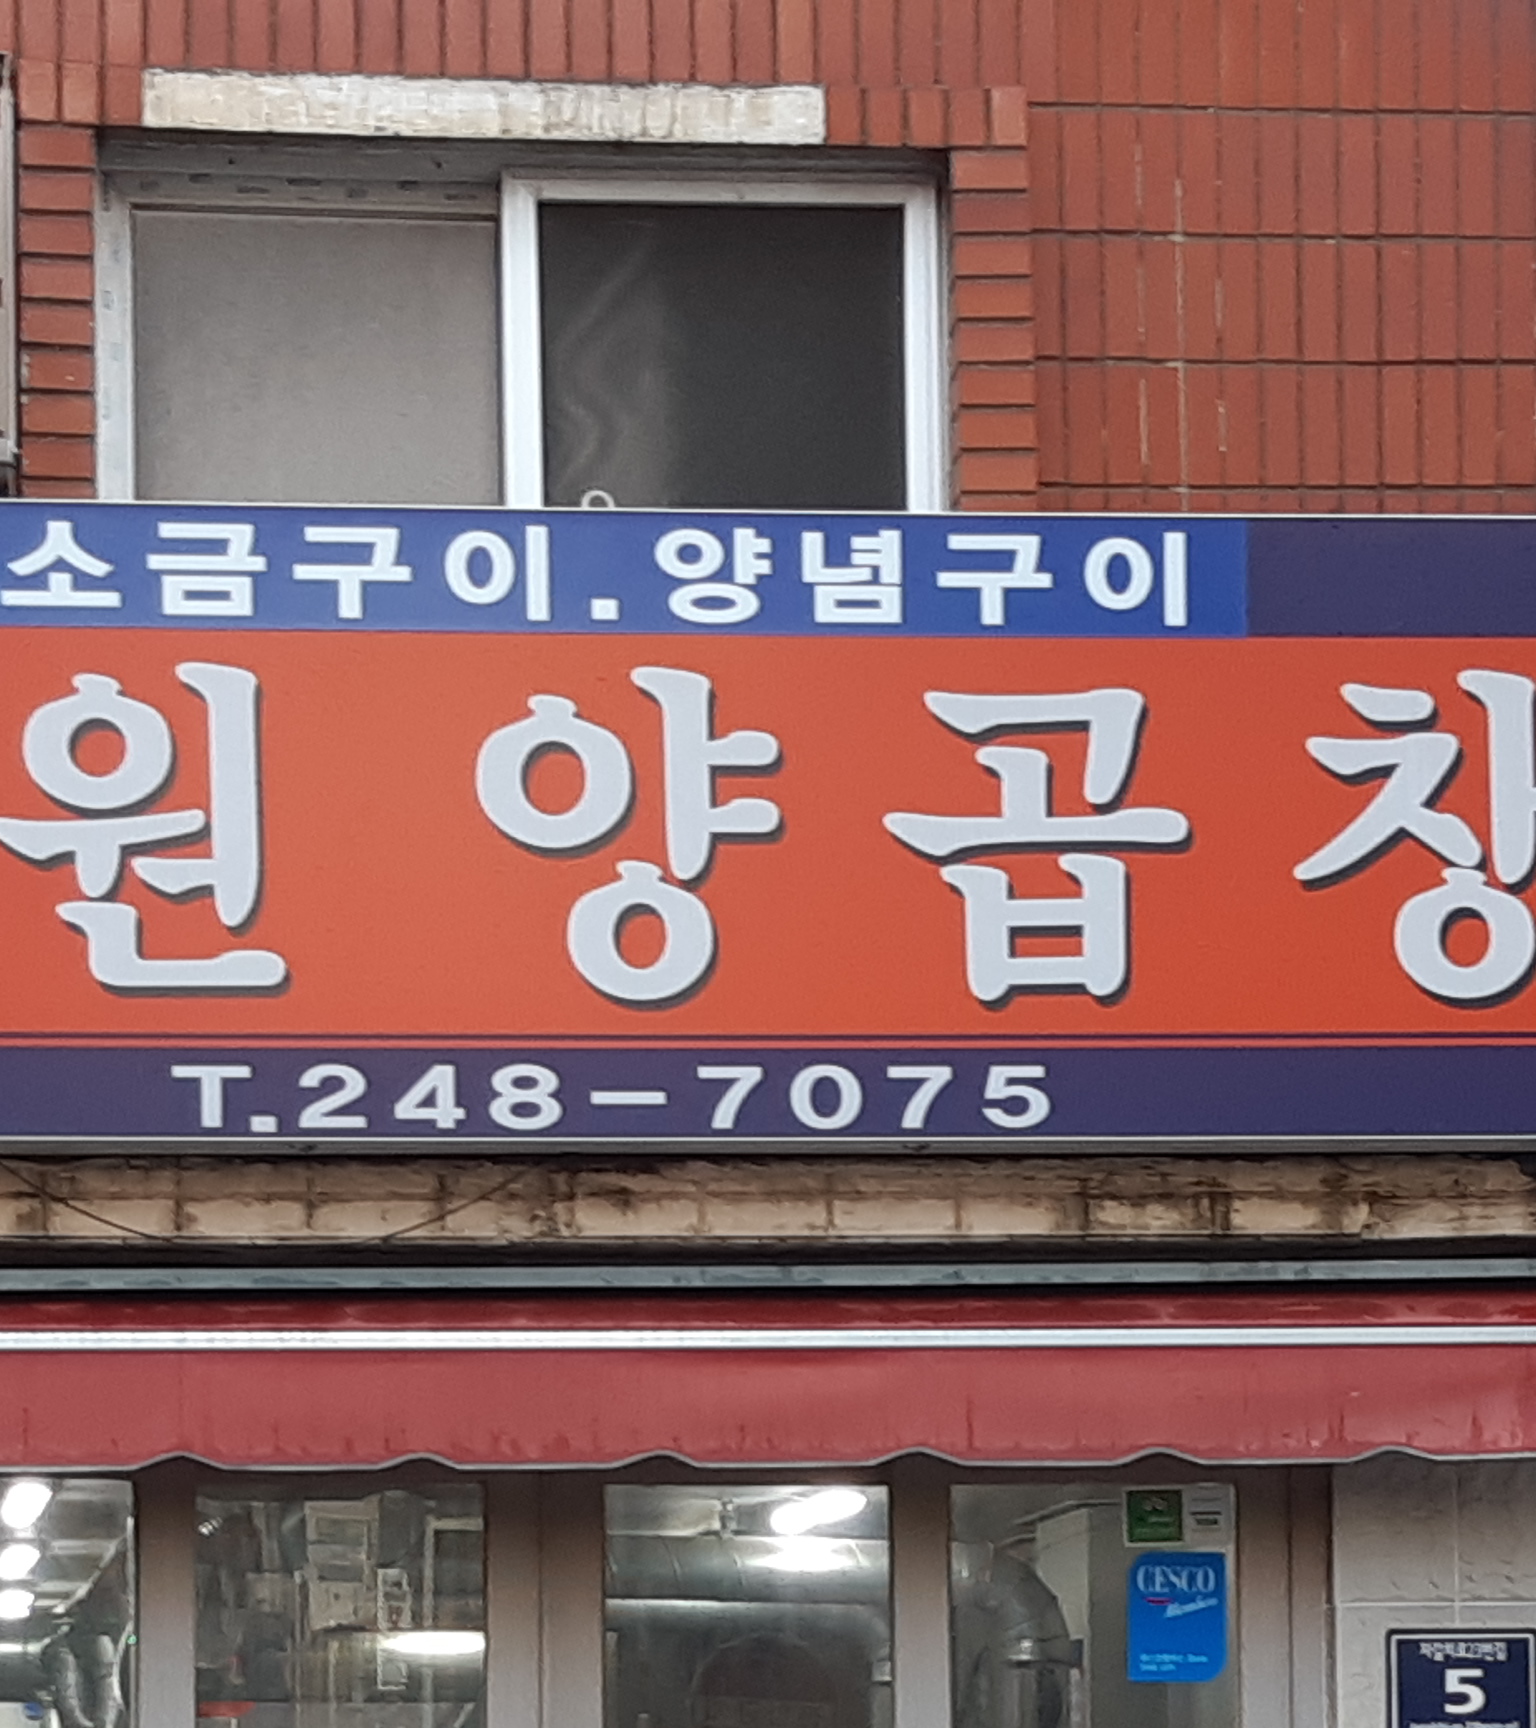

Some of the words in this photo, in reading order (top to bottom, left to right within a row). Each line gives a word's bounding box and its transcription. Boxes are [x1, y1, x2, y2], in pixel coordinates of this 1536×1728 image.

[654, 527, 1188, 626] 양념구이
[1136, 1565, 1216, 1593] CESCO
[1444, 1668, 1486, 1714] 5
